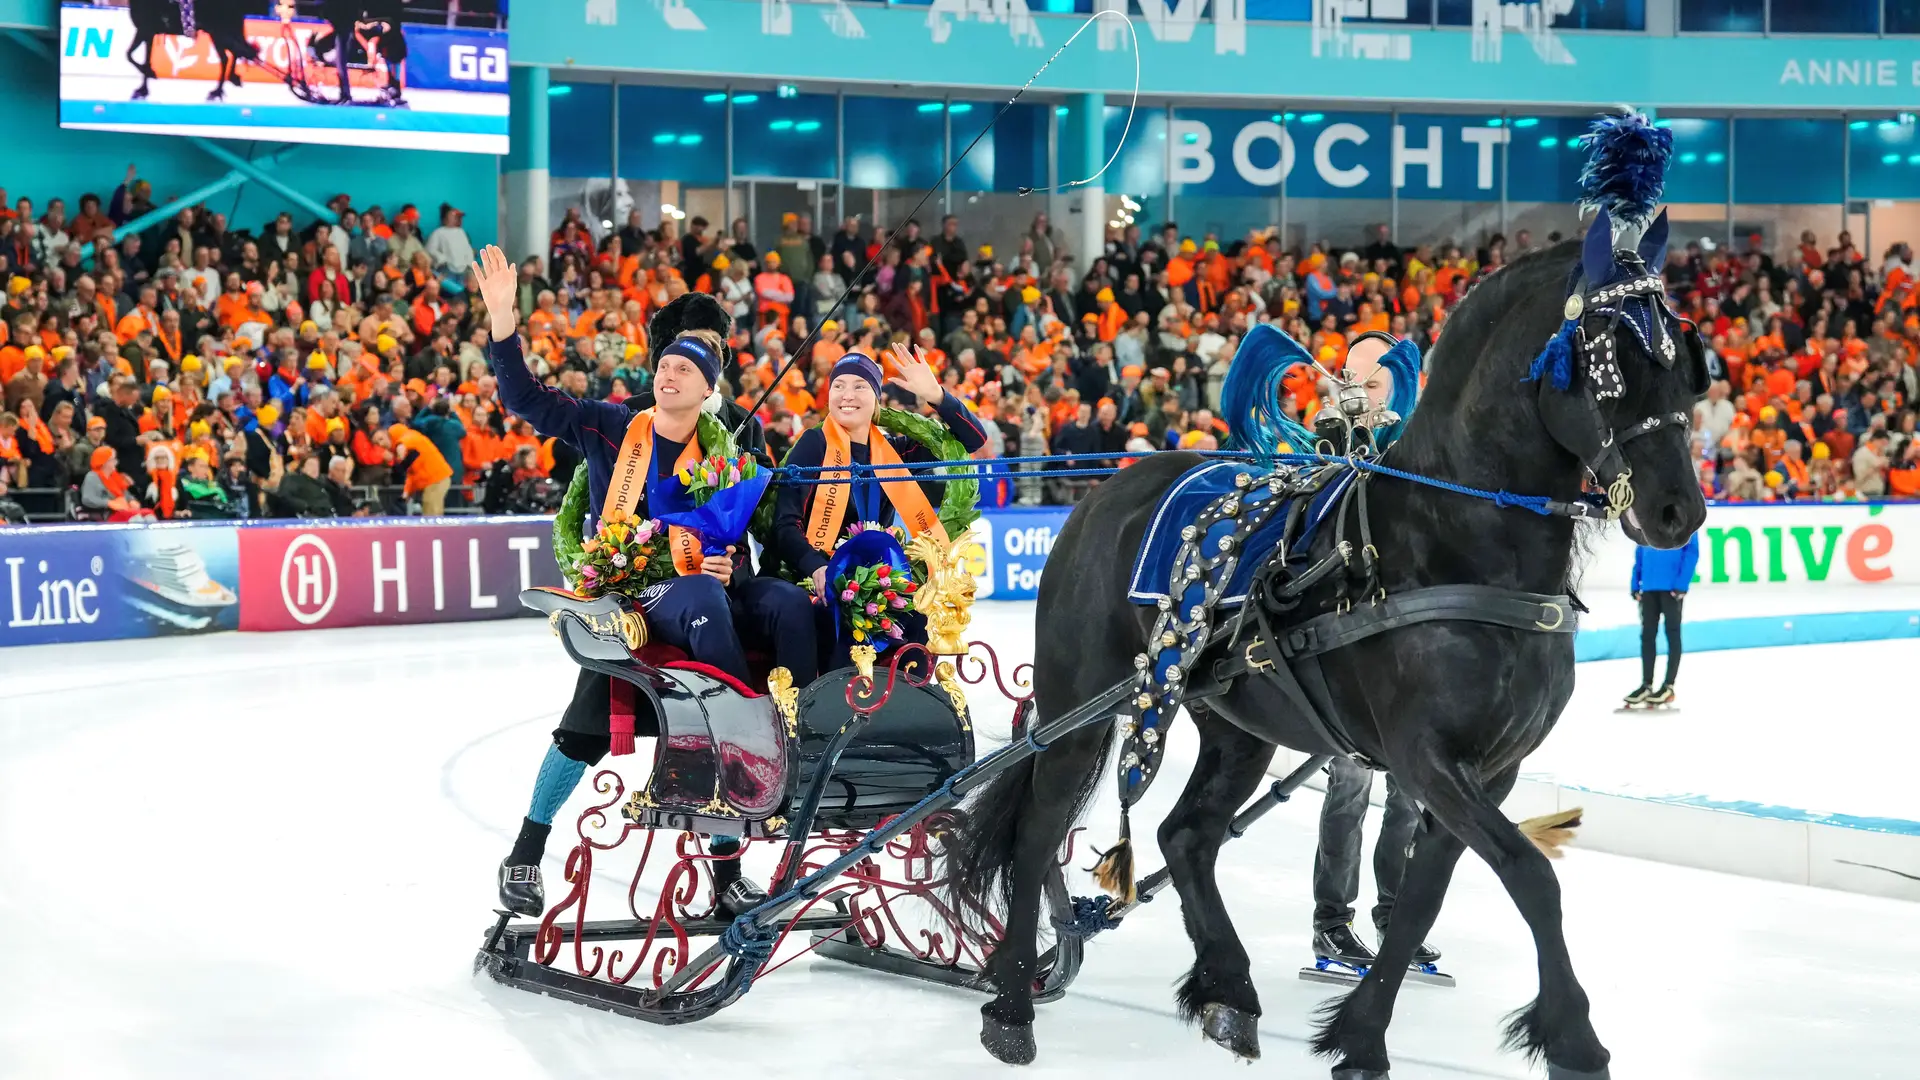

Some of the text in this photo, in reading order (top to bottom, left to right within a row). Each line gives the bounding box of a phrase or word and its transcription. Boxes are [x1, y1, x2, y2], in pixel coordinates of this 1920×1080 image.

[65, 27, 114, 58] IN
[1780, 59, 1898, 86] ANNIE
[1165, 120, 1511, 190] BOCHT
[1690, 505, 1894, 583] nivé
[372, 536, 576, 612] HILT
[691, 616, 709, 628] FILA
